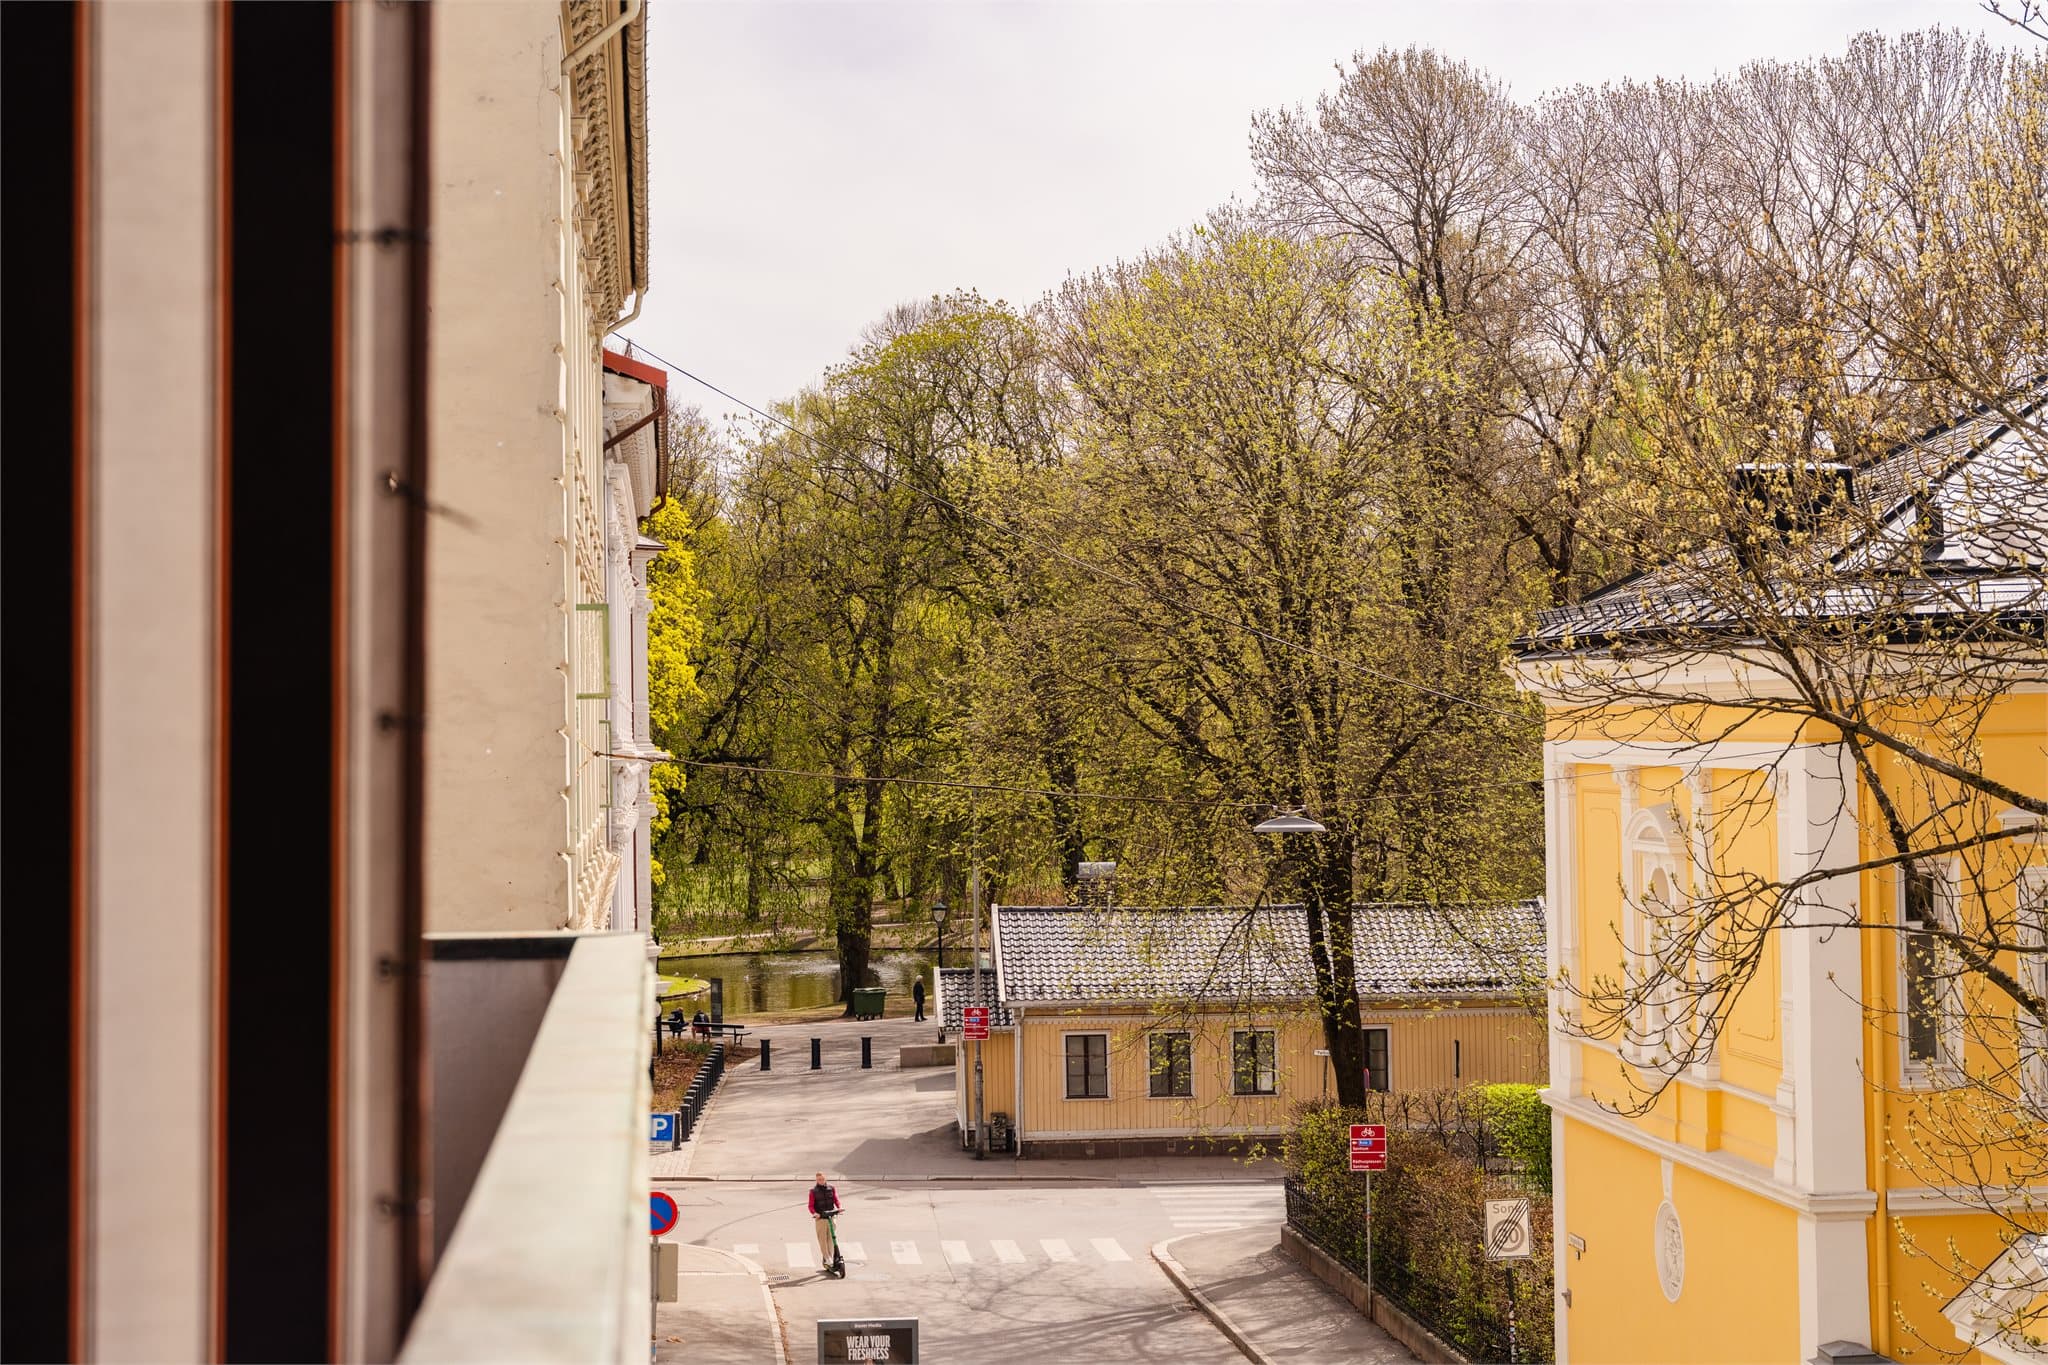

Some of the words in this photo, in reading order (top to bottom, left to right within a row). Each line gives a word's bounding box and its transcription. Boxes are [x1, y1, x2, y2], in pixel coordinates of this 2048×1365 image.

[652, 1118, 668, 1138] P
[846, 1335, 870, 1349] WEAR
[870, 1335, 891, 1348] YOUR
[848, 1348, 890, 1361] FRESHNESS
